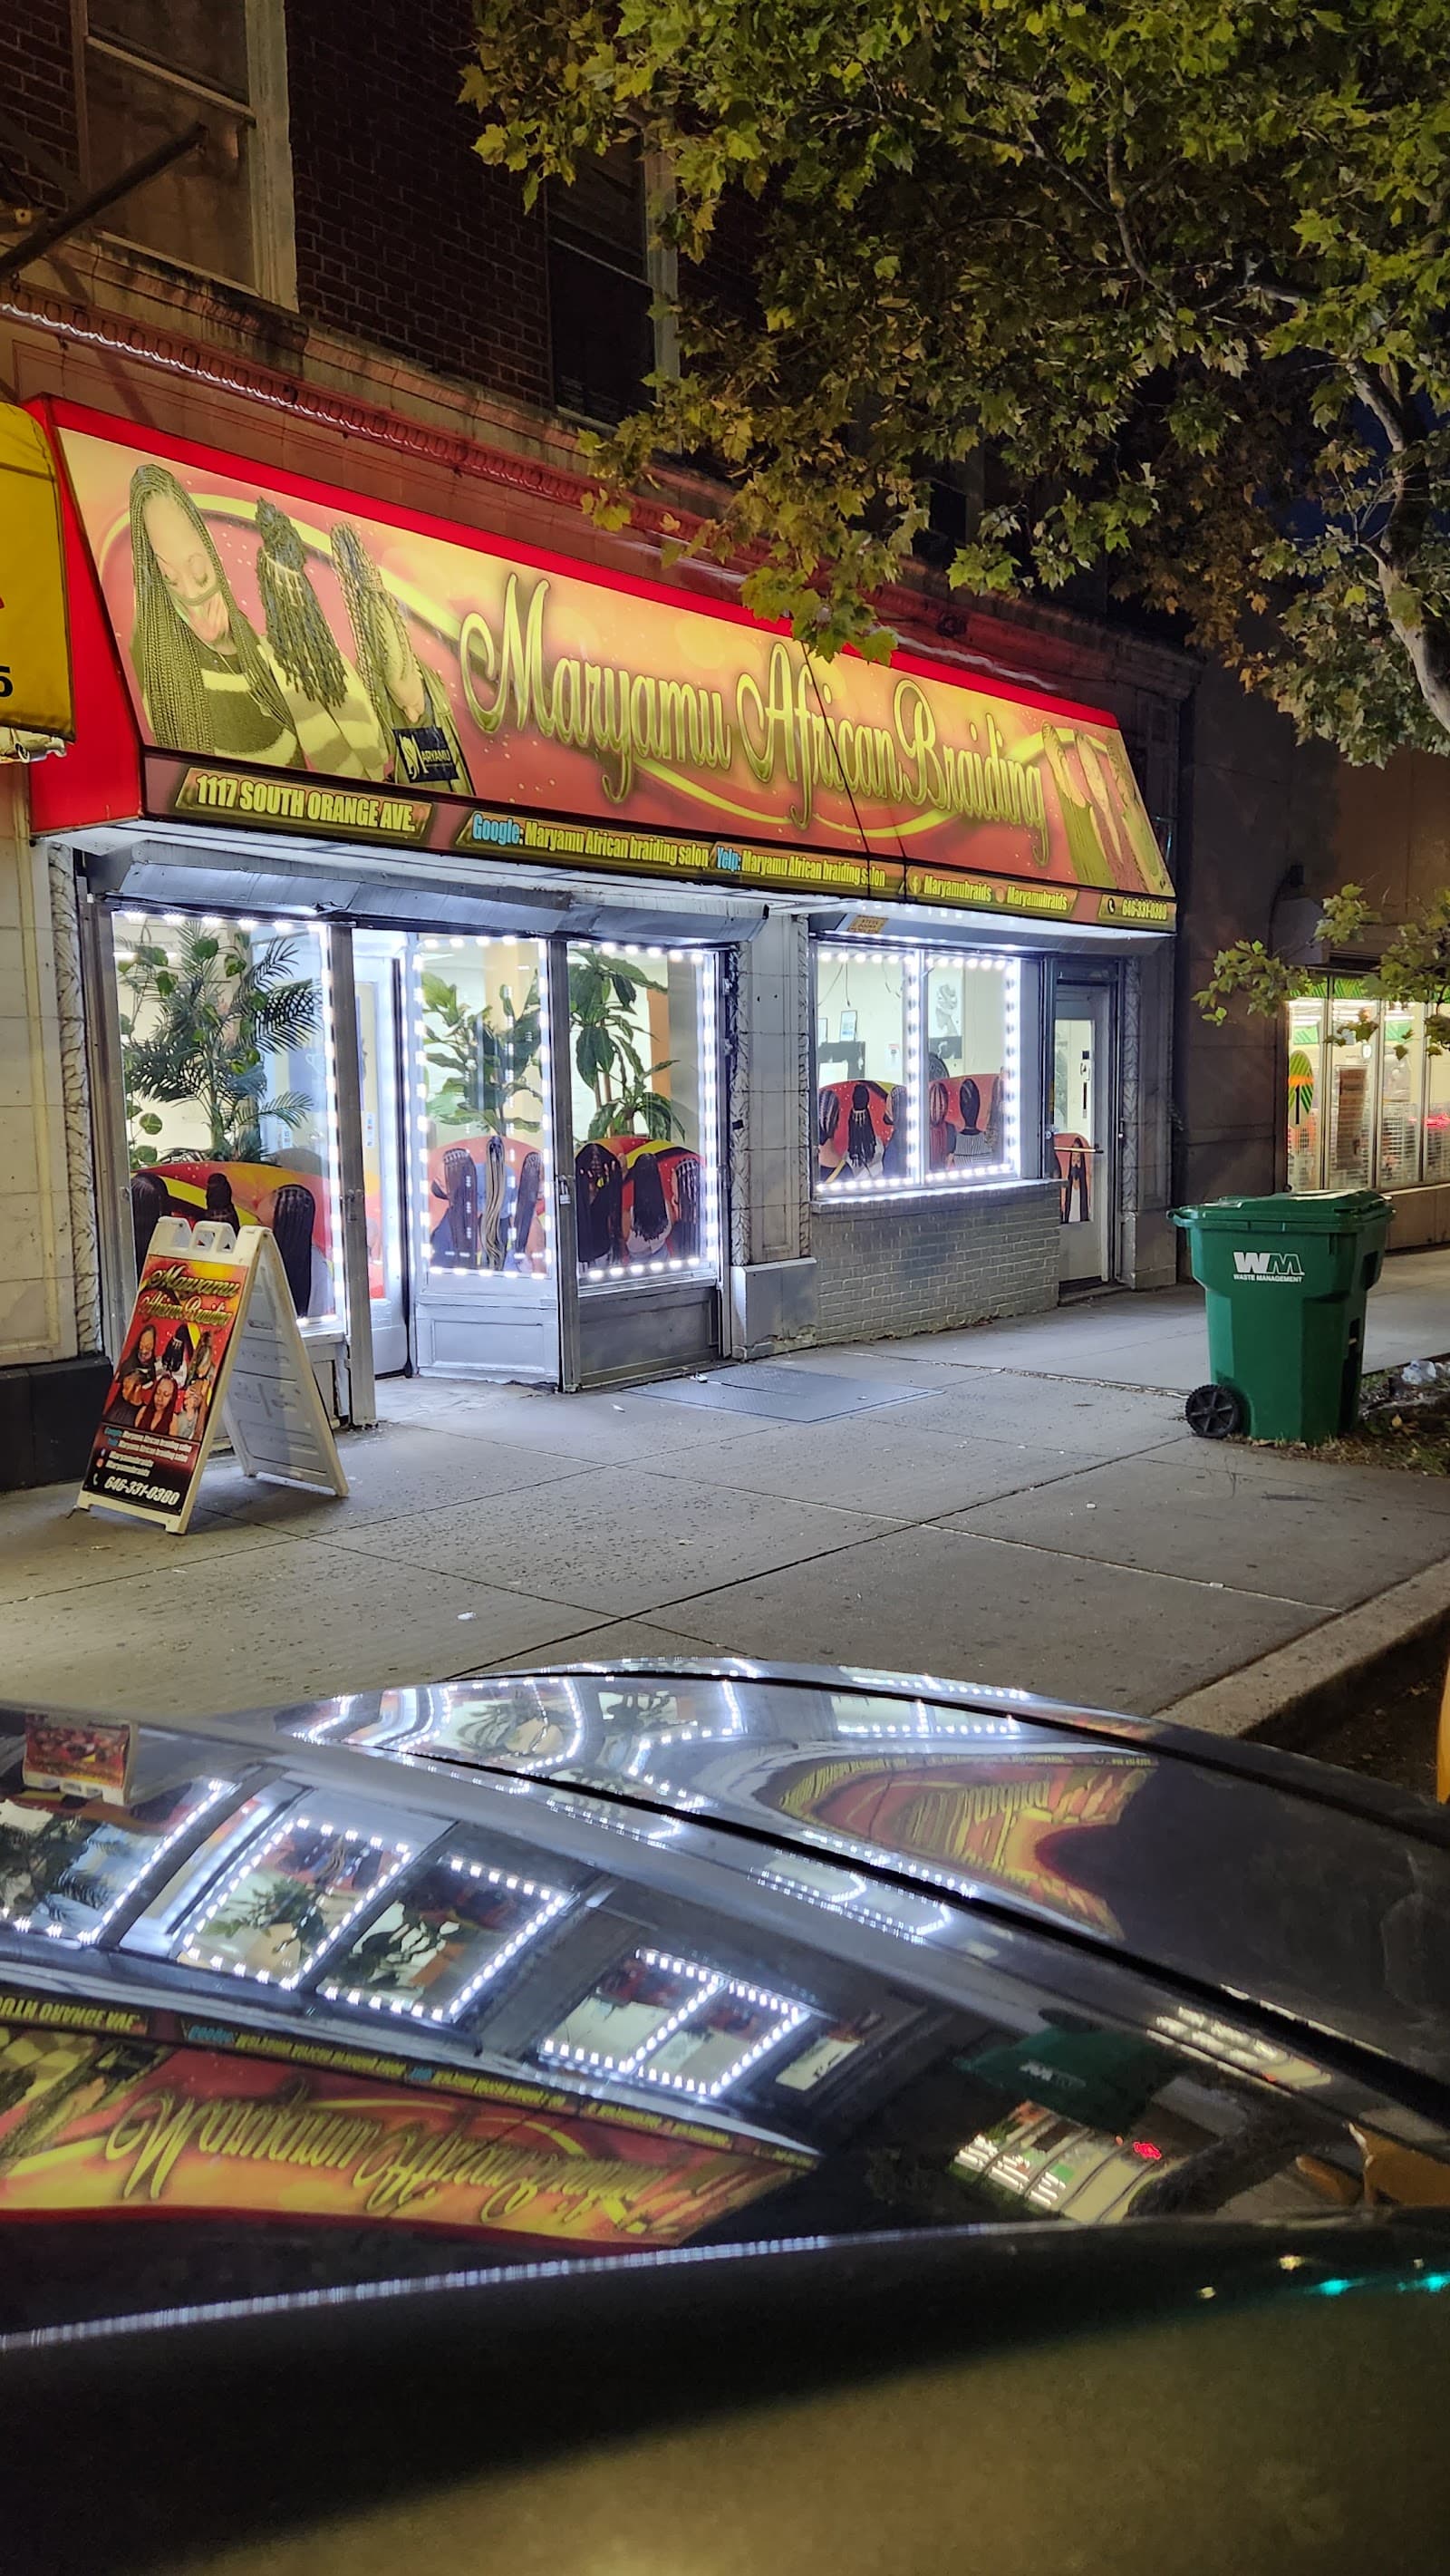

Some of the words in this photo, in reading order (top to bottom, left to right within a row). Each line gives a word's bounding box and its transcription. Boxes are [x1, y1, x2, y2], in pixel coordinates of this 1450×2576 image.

[460, 573, 732, 803] Maryamu
[736, 641, 904, 831] African
[893, 678, 1050, 867] Braiding
[196, 773, 238, 809] 1117
[239, 780, 305, 818] SOUTH
[307, 791, 381, 828] ORANGE
[380, 802, 416, 833] AVE.
[472, 813, 524, 846] Google:
[525, 820, 585, 852] Maryamu
[585, 829, 629, 859] African
[630, 834, 678, 867] braiding
[678, 842, 710, 867] salon
[716, 847, 741, 873] Yelp:
[741, 850, 788, 876] Maryamu
[788, 855, 822, 880] African
[823, 858, 861, 886] braiding
[923, 875, 992, 902] Maryamubraids
[1007, 885, 1068, 911] Maryamubraids
[1233, 1273, 1256, 1282] WASTE
[1256, 1274, 1303, 1283] MANAGEMENT
[103, 1476, 181, 1506] 646-331-0380
